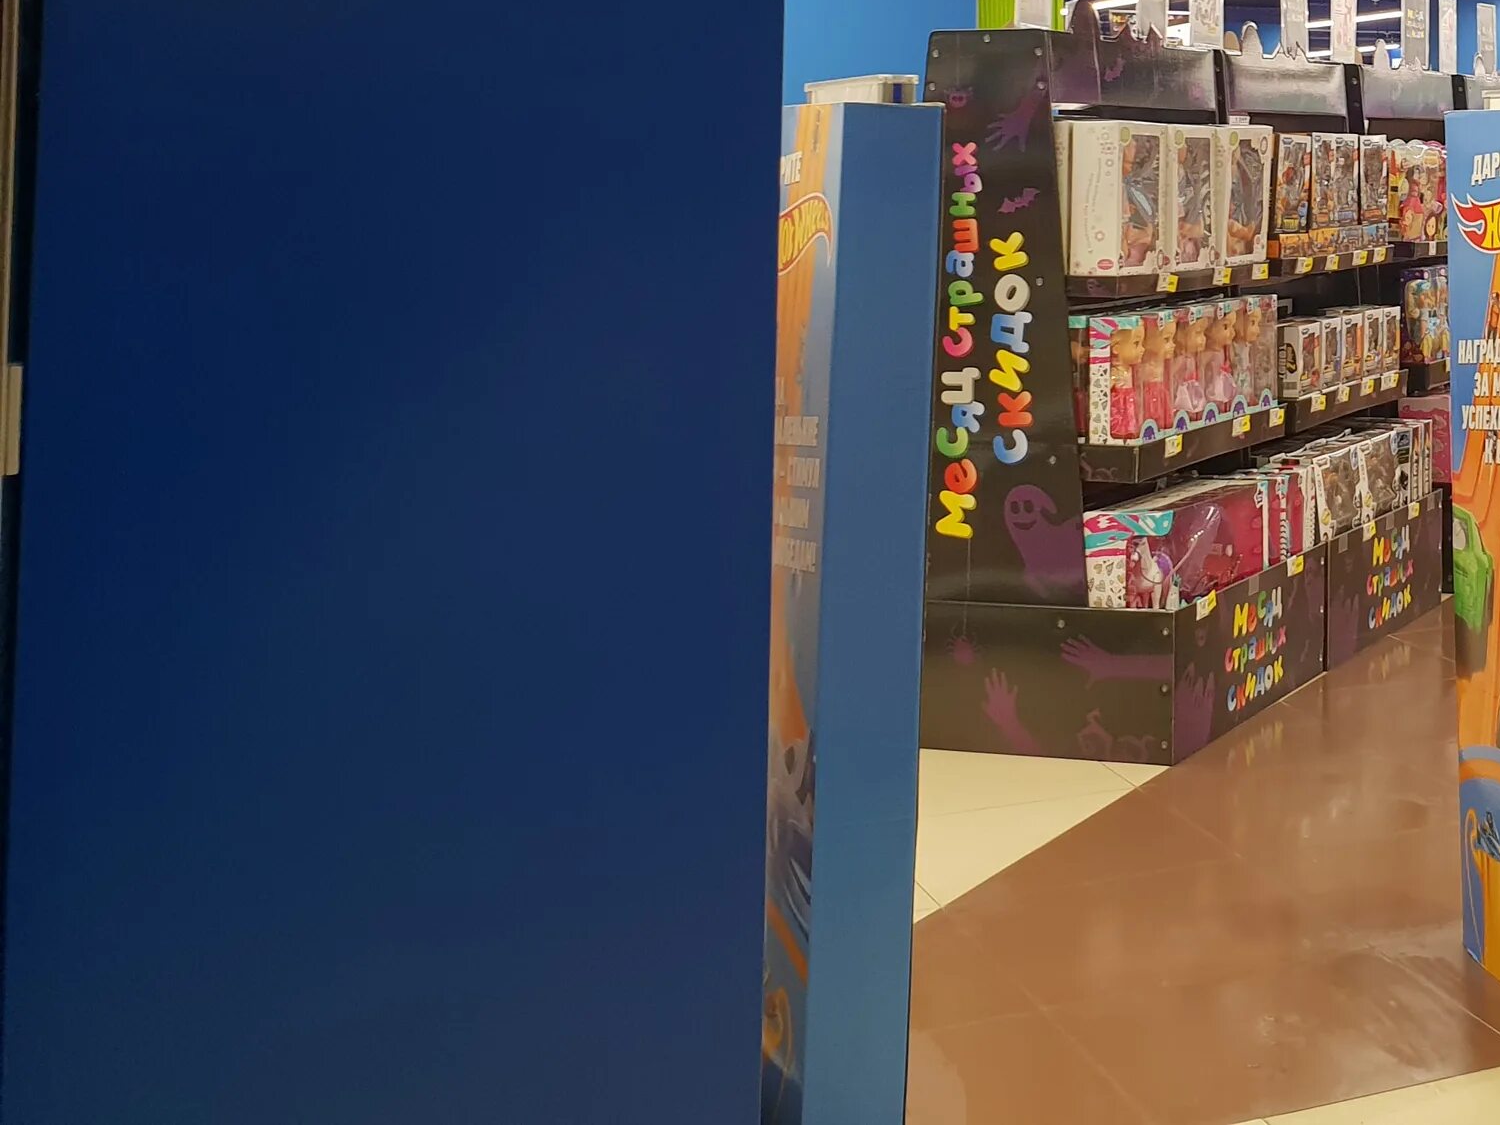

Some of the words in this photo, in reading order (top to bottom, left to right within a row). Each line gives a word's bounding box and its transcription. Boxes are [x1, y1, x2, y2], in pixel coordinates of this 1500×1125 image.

[989, 232, 1033, 465] скидок
[1473, 372, 1489, 397] ЗА
[1484, 439, 1493, 465] К
